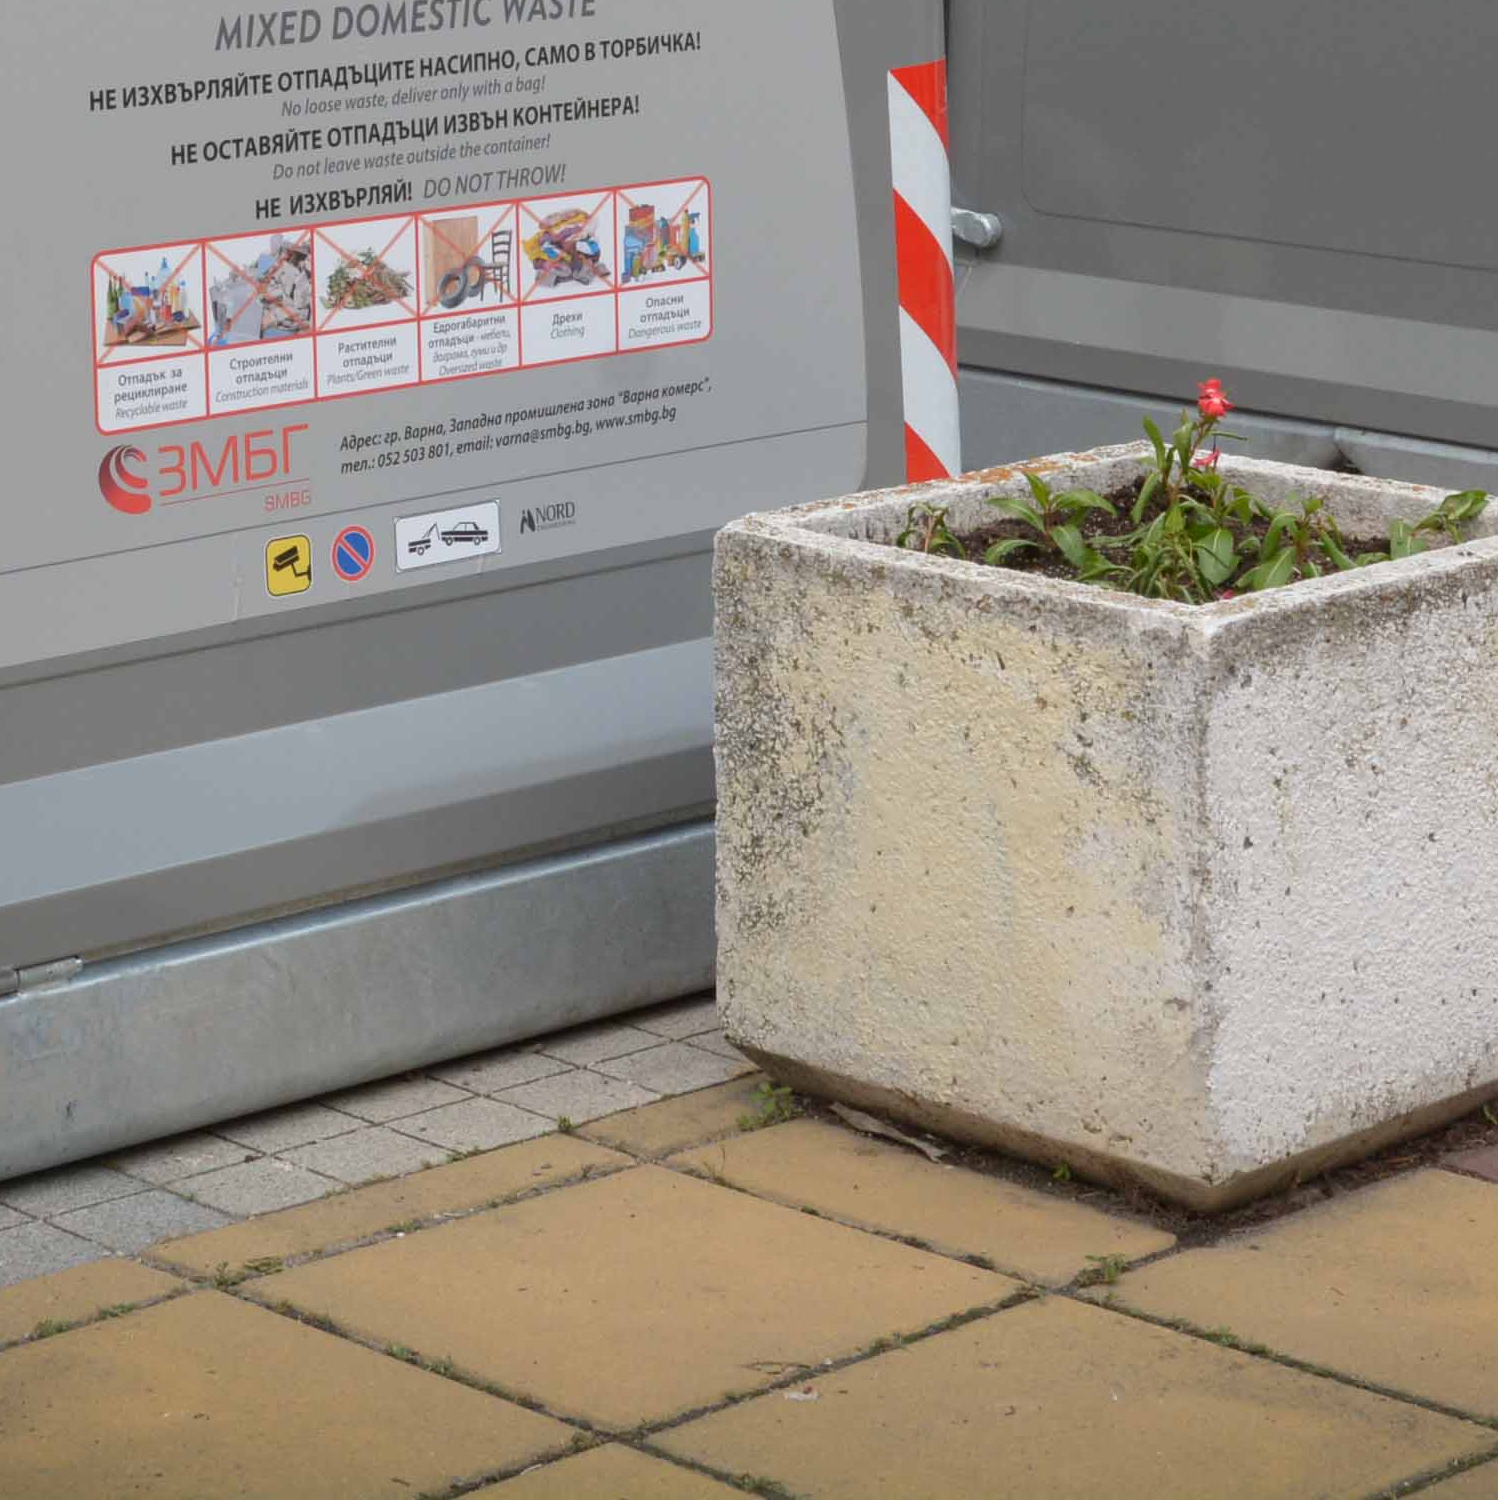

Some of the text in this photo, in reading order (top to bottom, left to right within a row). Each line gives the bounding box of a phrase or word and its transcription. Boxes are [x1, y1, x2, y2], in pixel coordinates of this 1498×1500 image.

[215, 10, 320, 50] MIXED
[90, 32, 700, 111] НЕ ИЗХВЪРЛЯЙТЕ ОТПАДЪЦИТЕ НАСИПНО, САМО В ТОРБИЧКА!
[282, 75, 545, 116] No loose waste, deliver only with a bag!
[172, 95, 639, 165] НЕ ОСТАВЯЙТЕ ОТПАДЪЦИ ИЗВЪН КОНТЕЙНЕРА!
[273, 132, 550, 180] Do not leave waste outside the container!
[256, 179, 412, 220] НЕ ИЗХВЪРЛЯЙ!
[424, 164, 565, 198] DO NOT THROW!
[158, 423, 309, 497] ЗМБГ
[264, 488, 311, 512] SMBG
[535, 501, 576, 524] NORD
